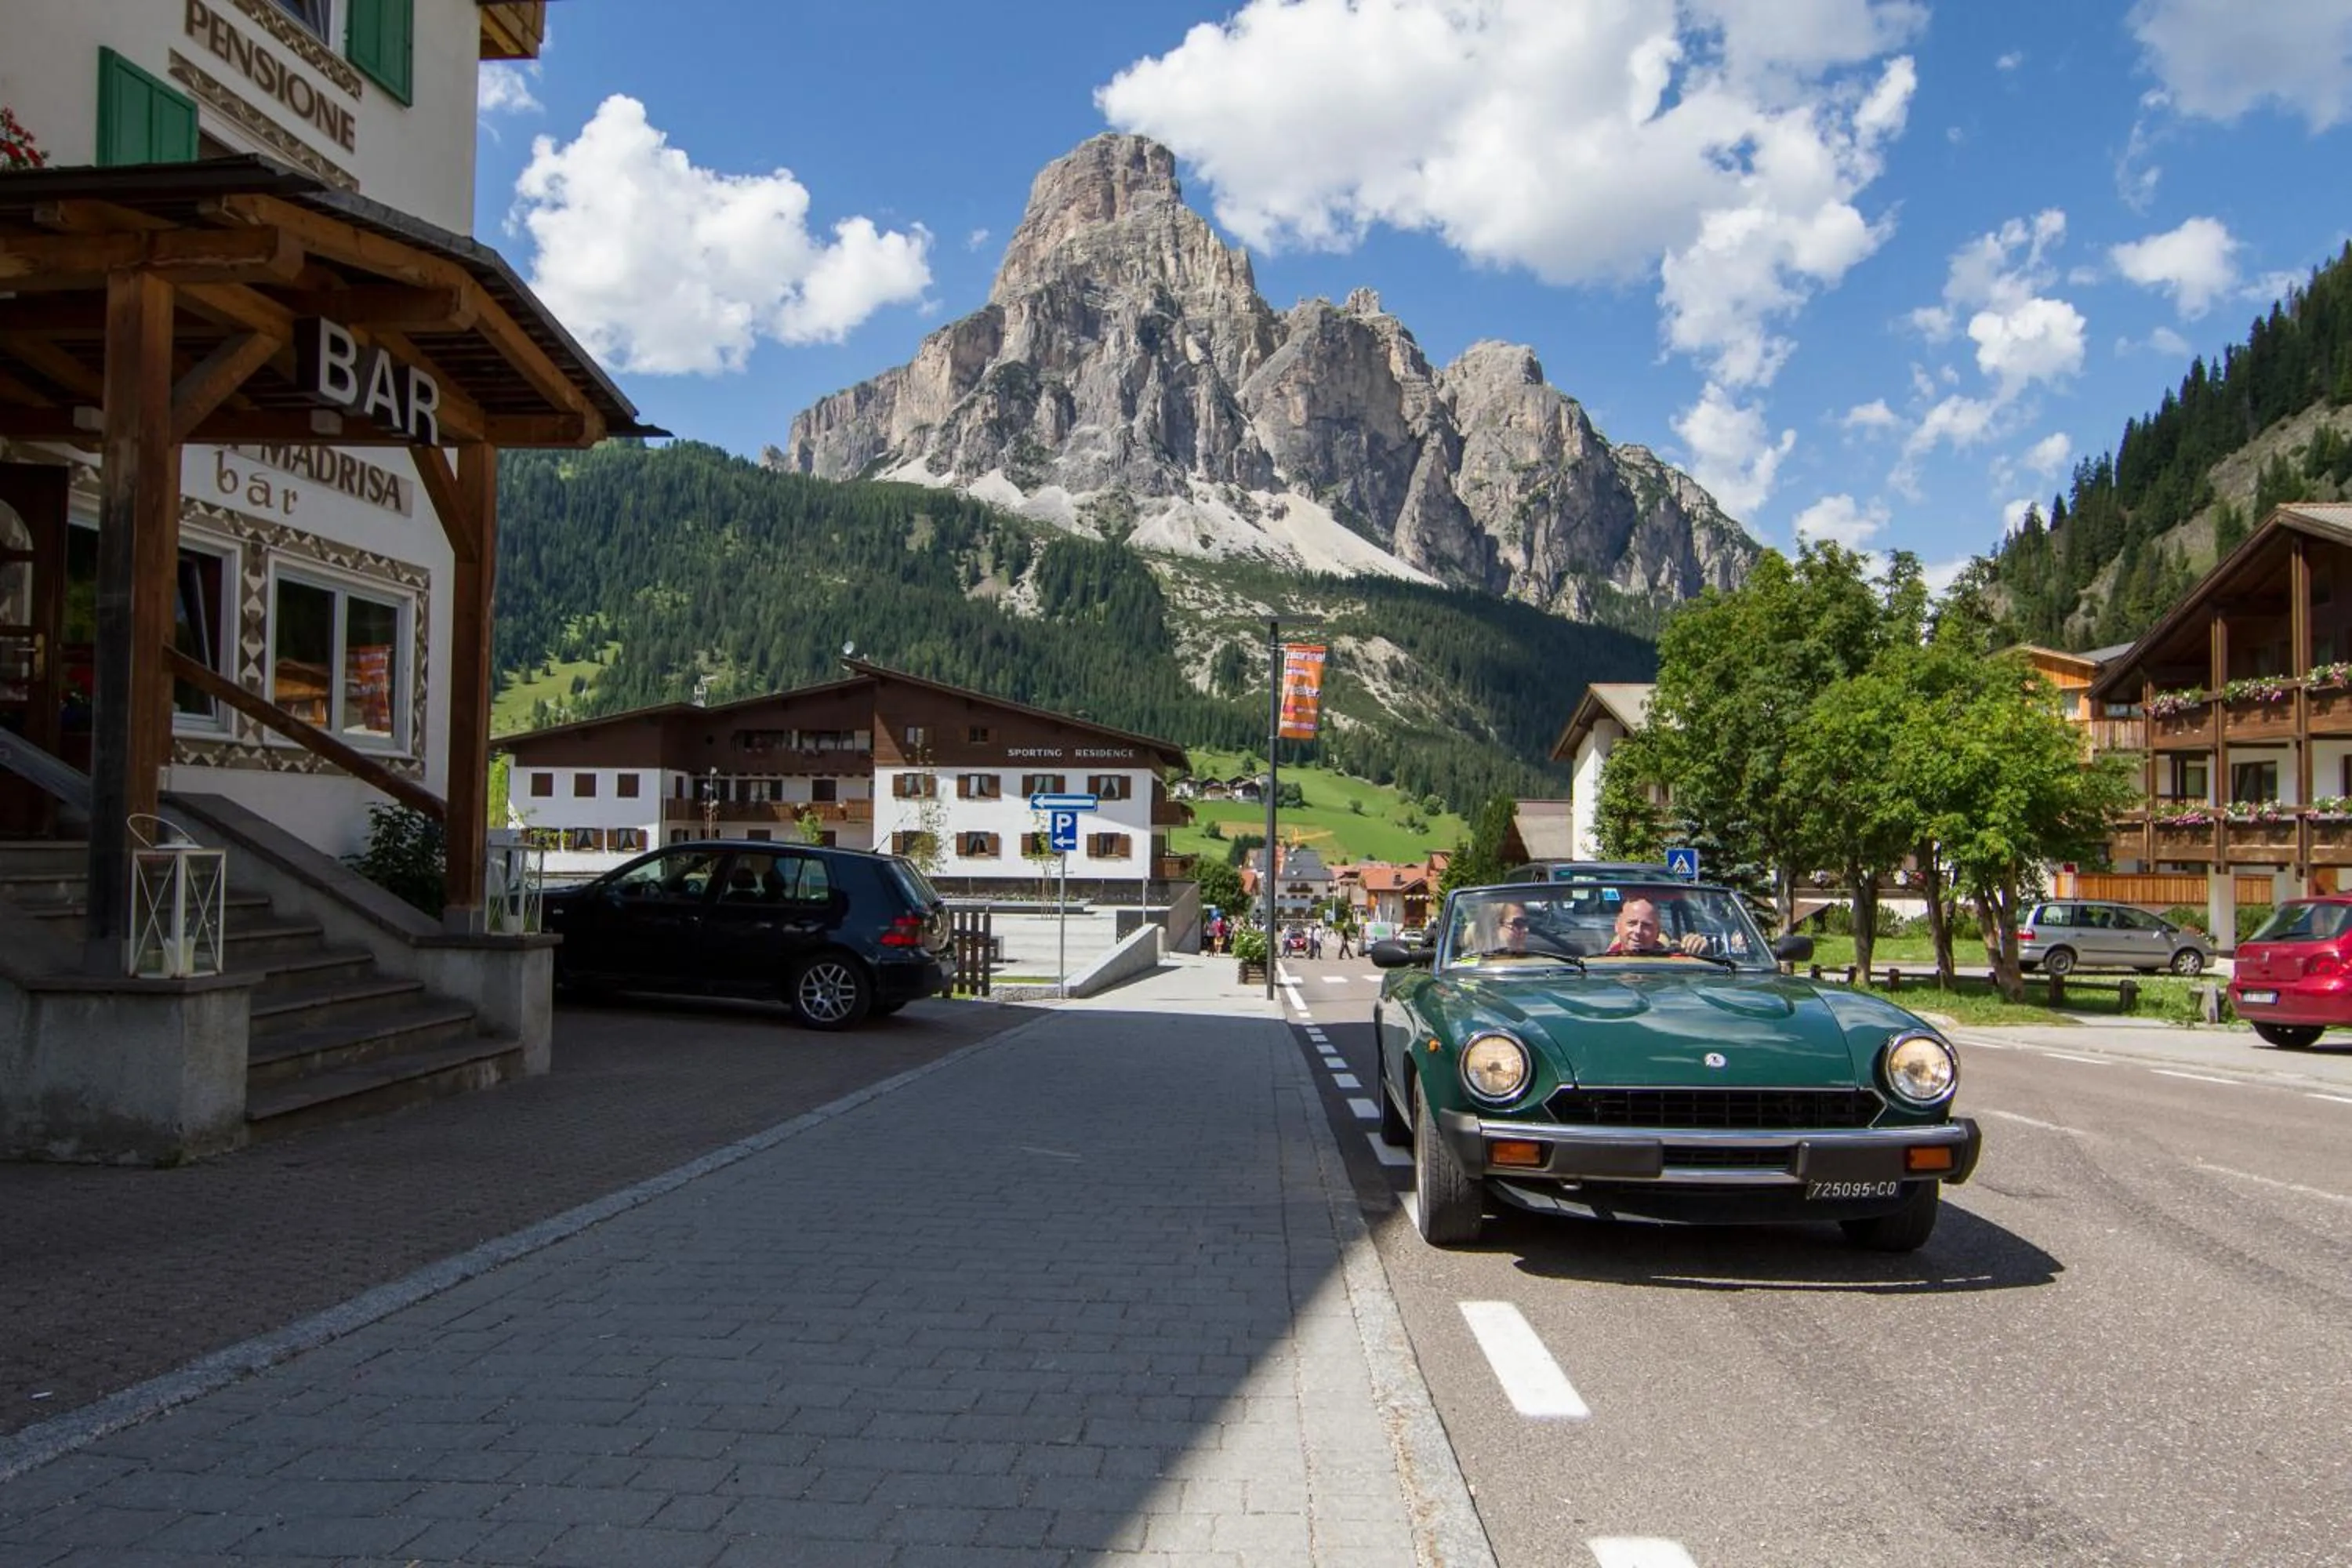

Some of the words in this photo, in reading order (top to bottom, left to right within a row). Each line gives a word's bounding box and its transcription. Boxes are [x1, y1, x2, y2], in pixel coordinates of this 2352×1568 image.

[185, 0, 355, 154] PENSIONE
[319, 316, 440, 446] BAR
[214, 450, 297, 515] bar
[1007, 748, 1063, 757] SPORTING
[1075, 749, 1134, 758] RESIDENCE
[1056, 813, 1073, 833] P
